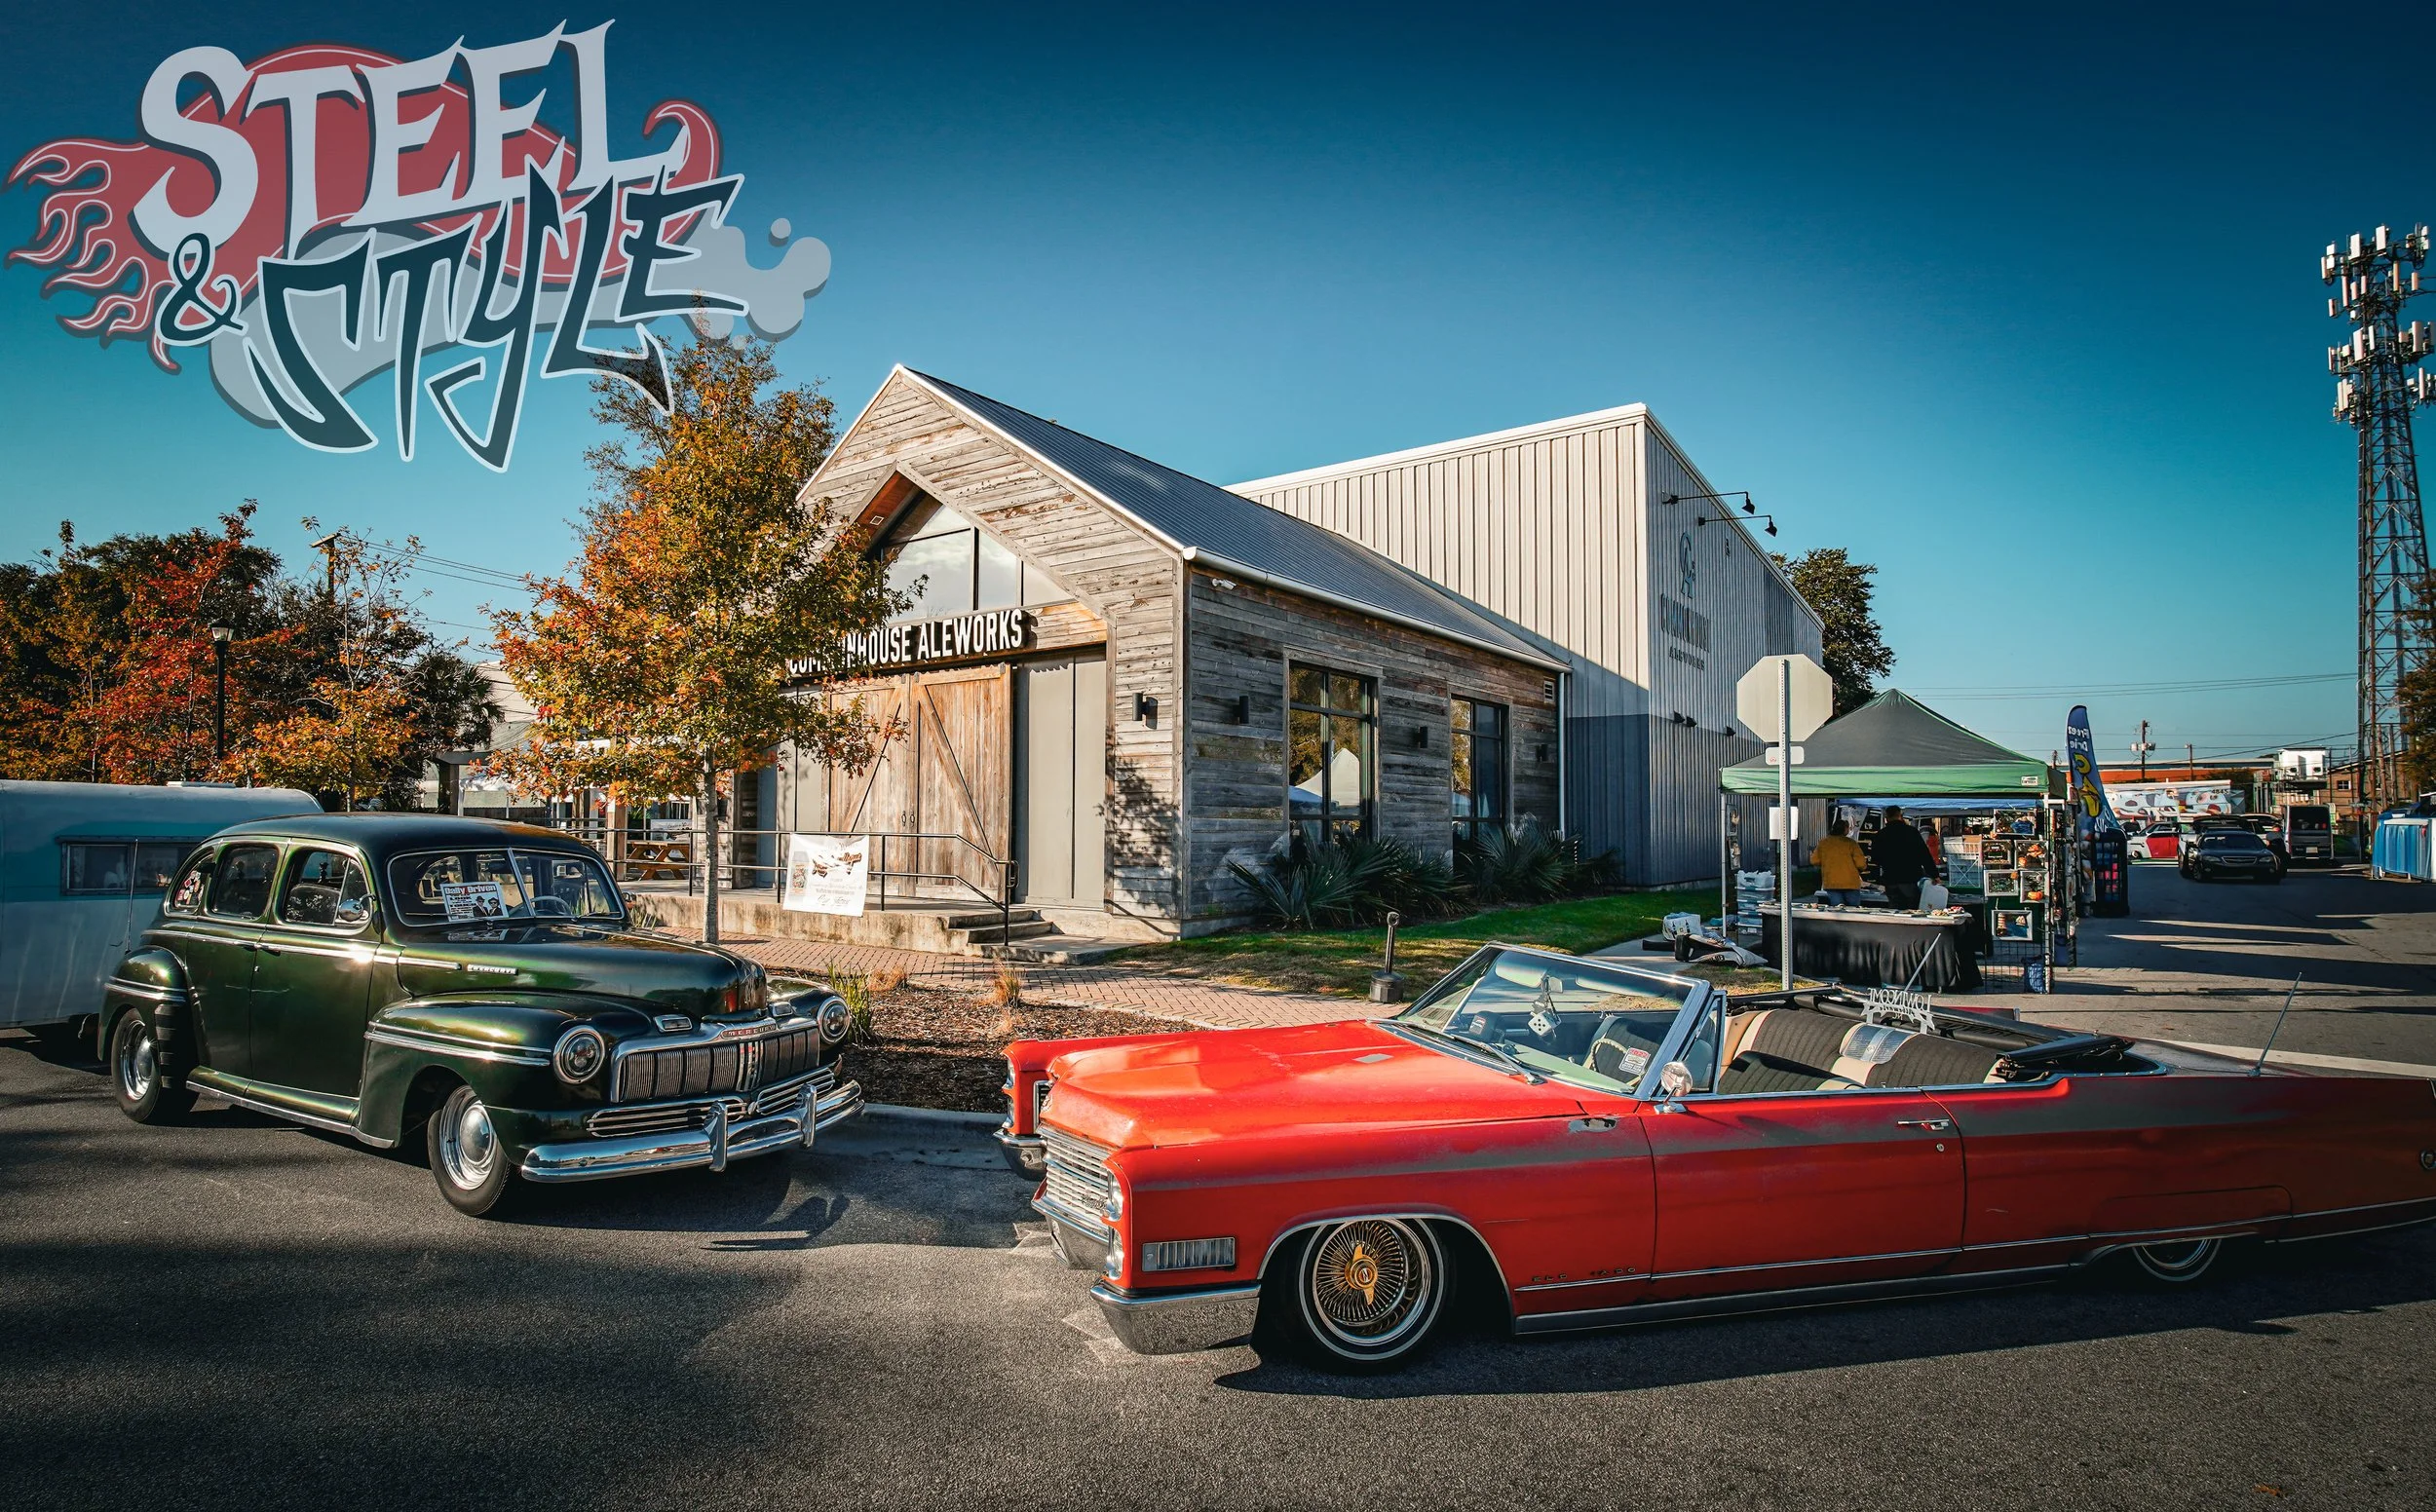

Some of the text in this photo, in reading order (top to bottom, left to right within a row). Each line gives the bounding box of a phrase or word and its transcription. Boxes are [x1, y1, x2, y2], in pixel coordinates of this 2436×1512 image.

[917, 608, 1023, 661] ALEWORKS
[467, 885, 496, 893] Driven
[728, 1024, 776, 1037] MERCURY
